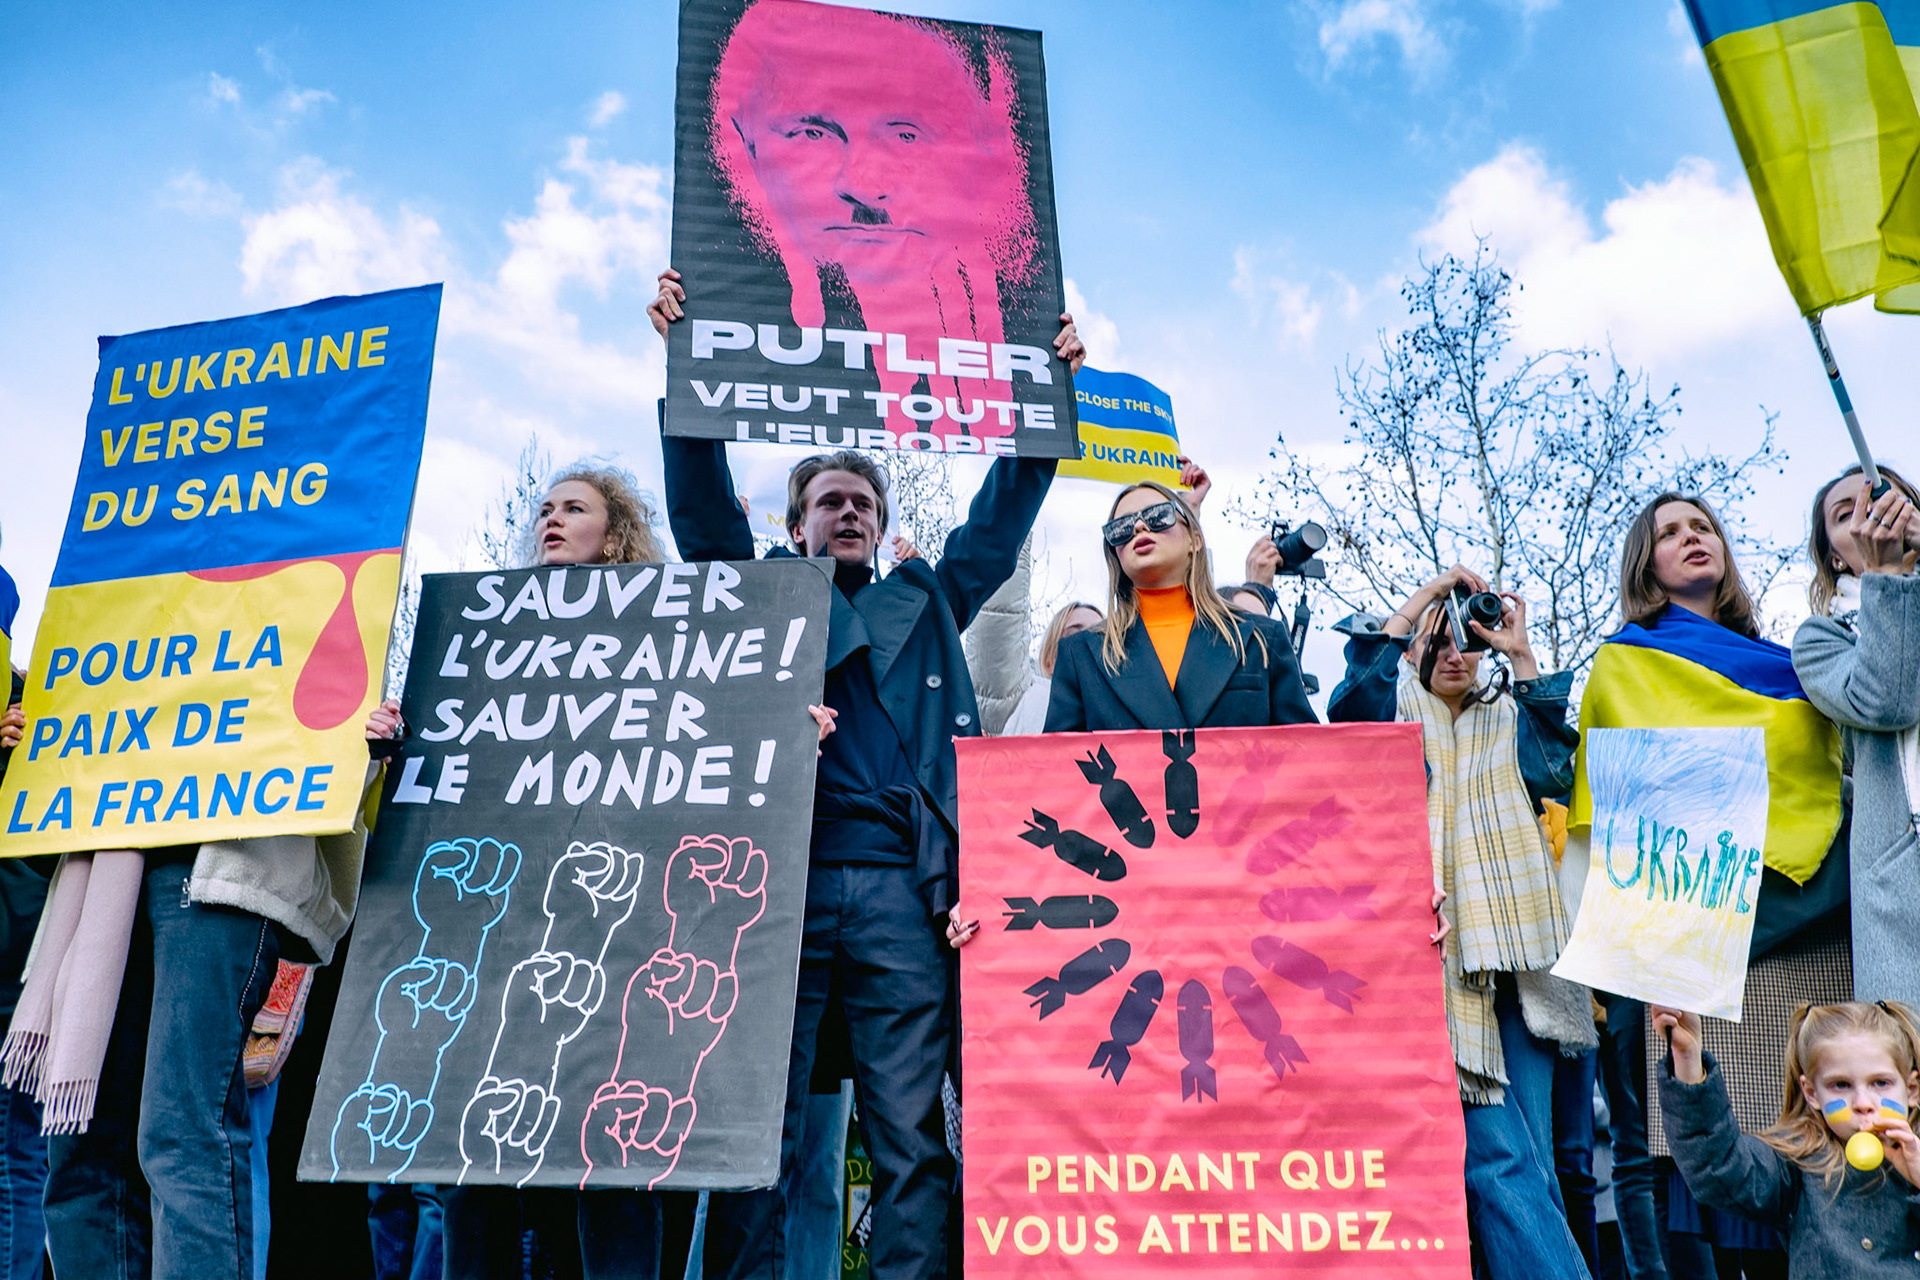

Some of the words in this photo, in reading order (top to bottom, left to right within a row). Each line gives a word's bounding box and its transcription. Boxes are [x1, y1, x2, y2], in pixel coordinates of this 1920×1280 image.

[108, 326, 389, 406] L'UKRAINE
[691, 318, 1053, 385] PUTLER
[690, 380, 850, 415] VEUT
[864, 390, 1056, 430] TOUTE
[1075, 390, 1120, 410] CLOSE
[1123, 398, 1151, 414] THE
[100, 406, 268, 467] VERSE
[82, 485, 160, 532] DU
[171, 462, 328, 521] SANG
[461, 560, 745, 625] SAUVER
[44, 634, 198, 690] POUR
[212, 625, 283, 673] LA
[28, 706, 158, 761] PAIX
[171, 698, 249, 746] DE
[420, 687, 709, 746] SAUVER
[7, 787, 73, 834] LA
[92, 764, 334, 827] FRANCE
[392, 753, 470, 805] LE
[1027, 1152, 1260, 1194] PENDANT
[1280, 1149, 1386, 1190] QUE
[976, 1214, 1119, 1256] VOUS
[1137, 1210, 1445, 1255] ATTENDEZ...
